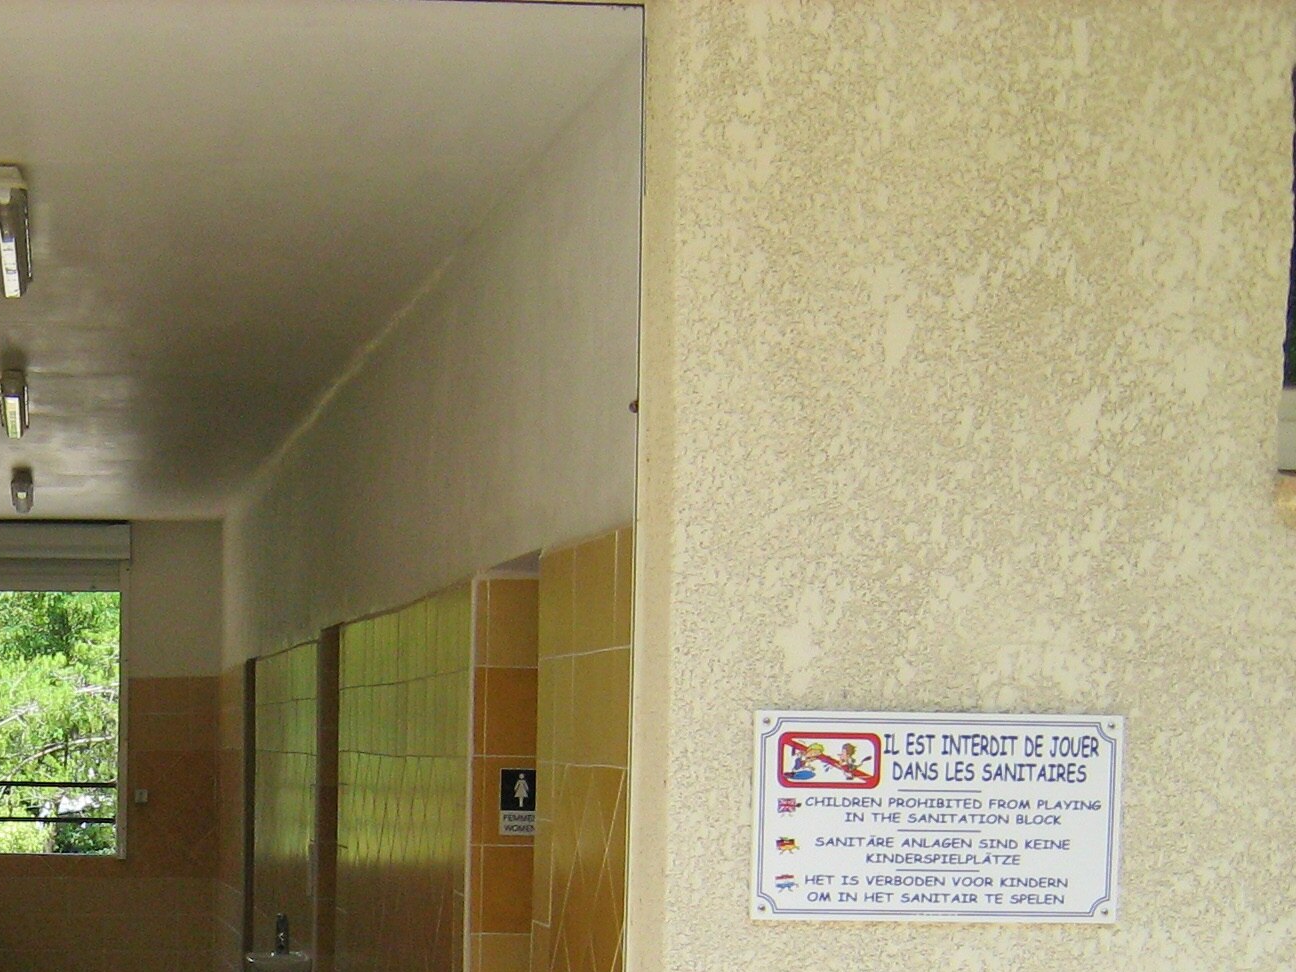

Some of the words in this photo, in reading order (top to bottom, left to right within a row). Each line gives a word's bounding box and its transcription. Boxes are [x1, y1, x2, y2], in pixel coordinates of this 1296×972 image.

[884, 734, 899, 755] IL
[906, 733, 936, 755] EST
[941, 734, 1018, 757] INTERDIT
[1024, 735, 1044, 757] DE
[1050, 734, 1099, 758] JOUER
[892, 761, 938, 781] DANS
[945, 761, 975, 782] LES
[982, 763, 1087, 783] SANITAIRES
[805, 797, 882, 808] CHILDREN
[888, 797, 982, 809] PROHIBITED
[989, 799, 1030, 809] FROM
[1037, 800, 1101, 811] PLAYING
[845, 812, 867, 823] IN
[872, 812, 901, 823] THE
[907, 813, 1009, 824] SANITATION
[1016, 814, 1061, 825] BLOCK
[815, 835, 894, 848] SANITÄRE
[901, 838, 972, 849] ANLAGEN
[979, 839, 1018, 849] SIND
[1025, 839, 1070, 850] KEINE
[866, 852, 1020, 865] KINDERSPIELPLÄTZE
[804, 875, 835, 886] HET
[841, 876, 859, 885] IS
[866, 875, 945, 887] VERBODEN
[952, 877, 993, 887] VOOR
[1000, 877, 1068, 888] KINDERN
[807, 892, 831, 902] OM
[838, 892, 857, 902] IN
[864, 892, 894, 903] HET
[901, 893, 977, 903] SANITAIR
[985, 893, 1003, 904] TE
[1010, 894, 1064, 905] SPELEN
